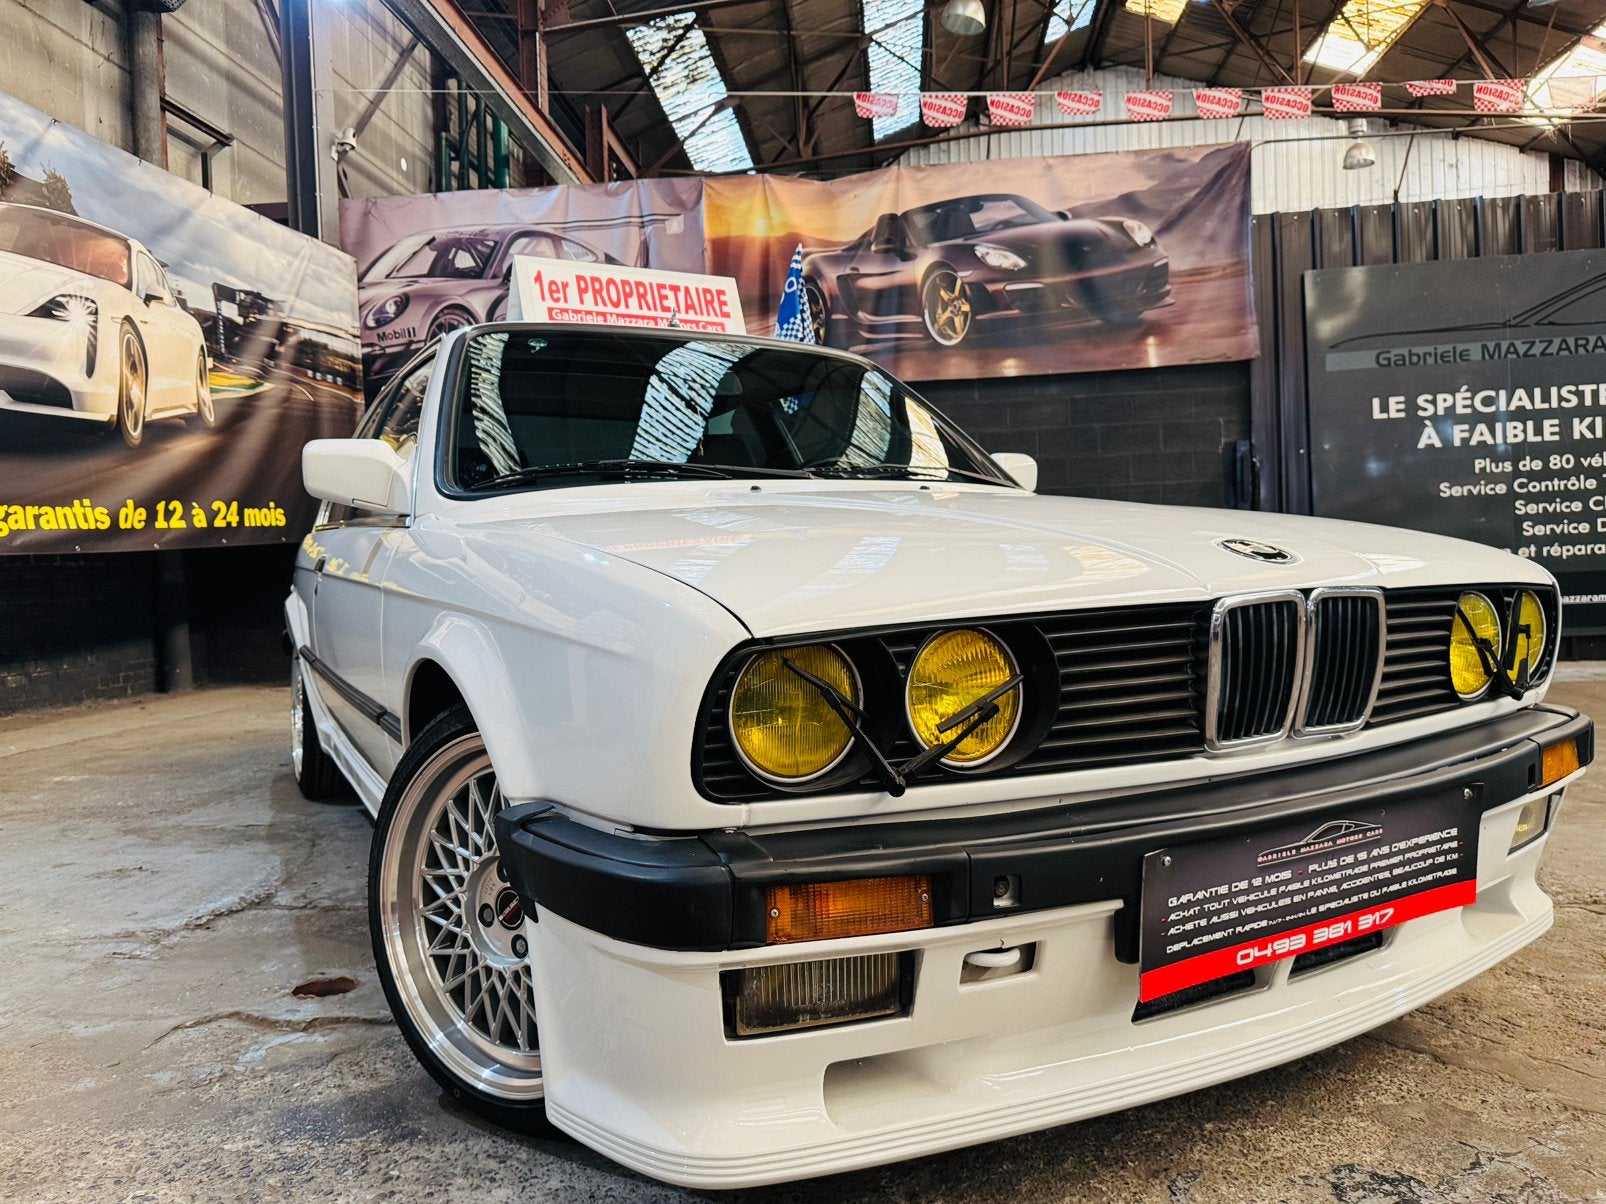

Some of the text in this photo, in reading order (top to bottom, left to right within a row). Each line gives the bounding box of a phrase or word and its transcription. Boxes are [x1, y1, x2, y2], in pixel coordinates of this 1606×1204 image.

[533, 269, 732, 319] 1er PROPRIETAIRE
[376, 328, 407, 342] Mobil
[551, 309, 723, 332] Gabriele Mazzara Mors Cars
[1375, 335, 1606, 368] Gabriele MAZZARA
[1371, 395, 1406, 420] LE
[1416, 415, 1603, 449] À FAIBLE KI
[1474, 457, 1513, 475] Plus
[1518, 455, 1543, 472] de
[1549, 453, 1575, 470] 80
[1439, 473, 1598, 498] Service Contrôle
[119, 499, 147, 530] de
[154, 500, 187, 530] 12
[191, 501, 208, 529] à
[211, 500, 239, 528] 24
[243, 501, 287, 527] mois
[1514, 498, 1583, 516] Service
[1522, 518, 1591, 537] Service
[1517, 543, 1537, 558] et
[1542, 542, 1606, 560] répara
[1168, 884, 1229, 908] GARANTIE
[1231, 880, 1249, 892] DE
[1251, 876, 1263, 887] 12
[1264, 869, 1292, 884] MOIS
[1308, 859, 1338, 874] PLUS
[1339, 854, 1355, 867] DE
[1356, 851, 1368, 862] 15
[1369, 845, 1390, 858] ANS
[1167, 906, 1201, 922] ACHAT
[1203, 899, 1230, 912] TOUT
[1232, 888, 1277, 905] VEHICULE
[1311, 864, 1368, 886] KILOMETRAGE
[1167, 919, 1208, 937] ACHETE
[1209, 911, 1239, 925] AUSSI
[1240, 897, 1292, 917] VEHICULES
[1293, 893, 1307, 903] EN
[1434, 854, 1446, 863] DE
[1446, 852, 1459, 862] KM
[1166, 928, 1236, 954] DEPLACEMENT
[1236, 919, 1268, 935] RAPIDE
[1306, 906, 1318, 915] LE
[1370, 888, 1381, 898] DU
[1236, 907, 1395, 967] 0493 381 317
